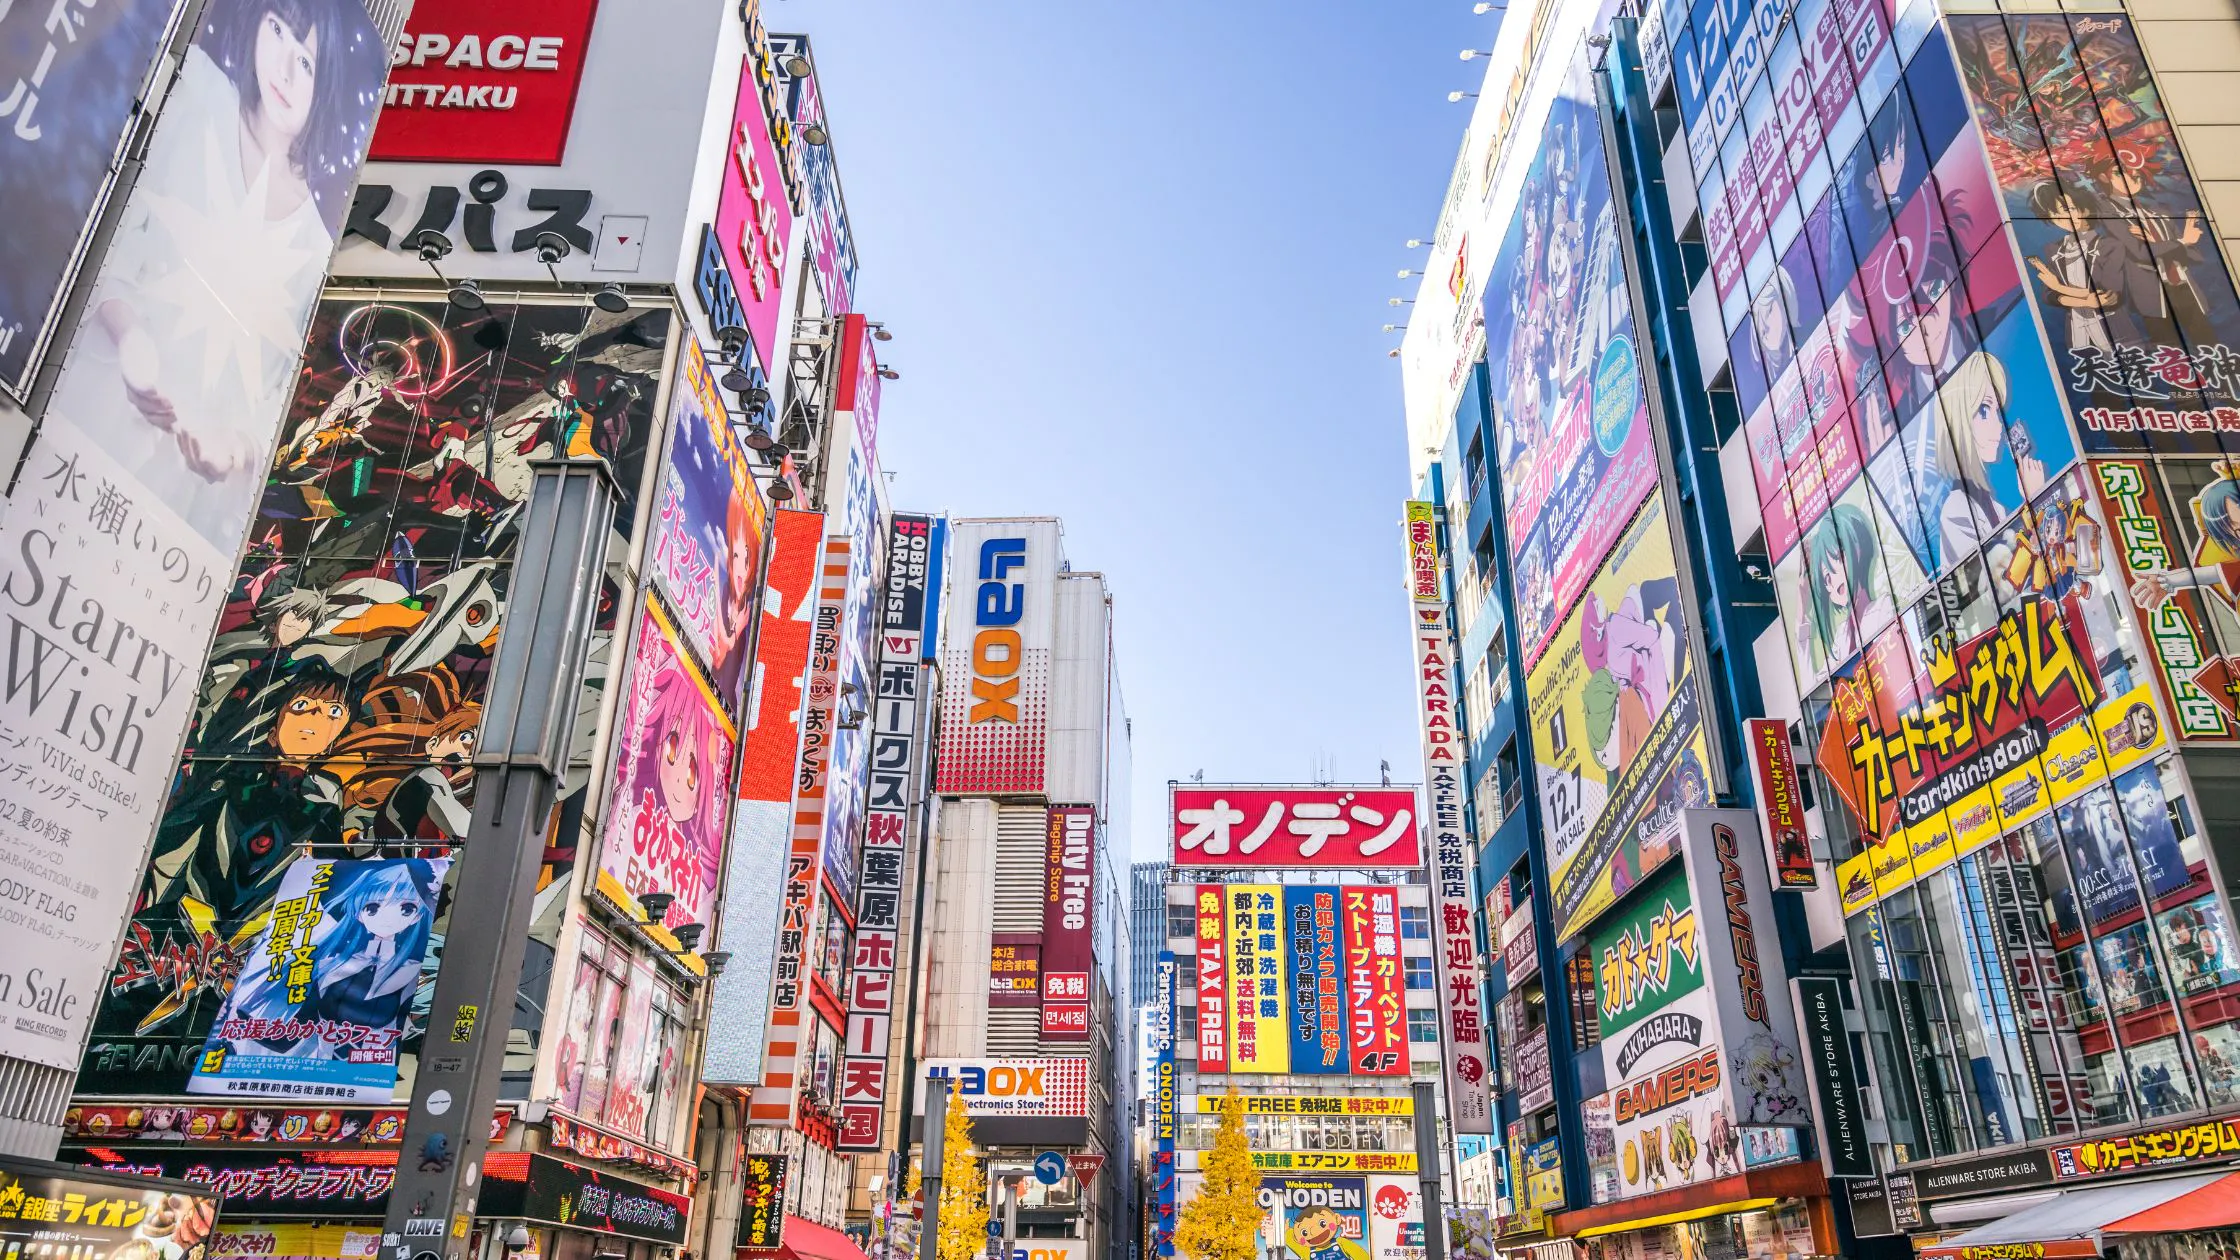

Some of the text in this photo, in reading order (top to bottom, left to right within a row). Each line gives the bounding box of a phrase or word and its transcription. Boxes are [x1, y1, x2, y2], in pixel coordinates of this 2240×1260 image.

[1854, 17, 1878, 63] 6F
[887, 520, 910, 625] PARADISE
[907, 522, 928, 591] HOBBY
[1411, 519, 1439, 597] まんが喫茶
[2, 528, 188, 718] Starry
[2102, 465, 2223, 732] カードゲム専門店
[0, 613, 147, 776] Wish
[1421, 637, 1454, 760] TAKARADA
[1851, 602, 2098, 838] カードキングダム
[1178, 792, 1412, 857] オノデン
[1549, 762, 1584, 834] 12.7
[1048, 813, 1064, 902] Flagship Store
[1437, 831, 1466, 898] 免税商店
[1556, 814, 1586, 857] ON SALE
[1062, 813, 1092, 931] Duty Free
[772, 854, 813, 1009] アキバ駅前店
[991, 946, 1016, 959] 本店
[1256, 892, 1279, 1018] 冷蔵庫 洗濯機
[1712, 822, 1772, 1031] GAMERS
[18, 968, 77, 1021] Sale
[1047, 977, 1085, 996] 免税
[1199, 892, 1223, 1062] 免税 TAX FREE
[1293, 904, 1317, 1041] お見積り無料です
[1314, 892, 1341, 1066] 防犯カメラ販売開始!!
[14, 1016, 37, 1031] KING
[35, 1022, 68, 1039] RECORDS
[217, 1017, 402, 1048] 応援ありがとうフェア
[1045, 1011, 1085, 1026] 면세점
[1159, 961, 1173, 1051] Panasonic
[350, 1049, 393, 1063] 開催中!!
[1358, 1051, 1399, 1072] 4F
[1623, 1015, 1693, 1072] AKIHABARA
[1016, 1099, 1046, 1110] Store
[1160, 1061, 1173, 1138] ONODEN
[1248, 1097, 1297, 1113] FREE
[1299, 1097, 1343, 1113] 免税店
[1614, 1049, 1722, 1127] GAMERS
[1814, 991, 1856, 1162] ALIENWARE STORE AKIBA
[1074, 1160, 1098, 1170] 止まれ
[1251, 1153, 1411, 1171] 冷蔵庫 エアコン 特売中!!
[1927, 1162, 2038, 1188] ALIENWARE STORE AKIBA
[2100, 1122, 2240, 1168] カードキングダム
[20, 1192, 147, 1229] 銀座ライオン
[1256, 1187, 1362, 1209] ONODEN
[1285, 1180, 1315, 1190] Welcome
[1852, 1178, 1880, 1190] ALIENWARE
[406, 1220, 444, 1236] DAVE
